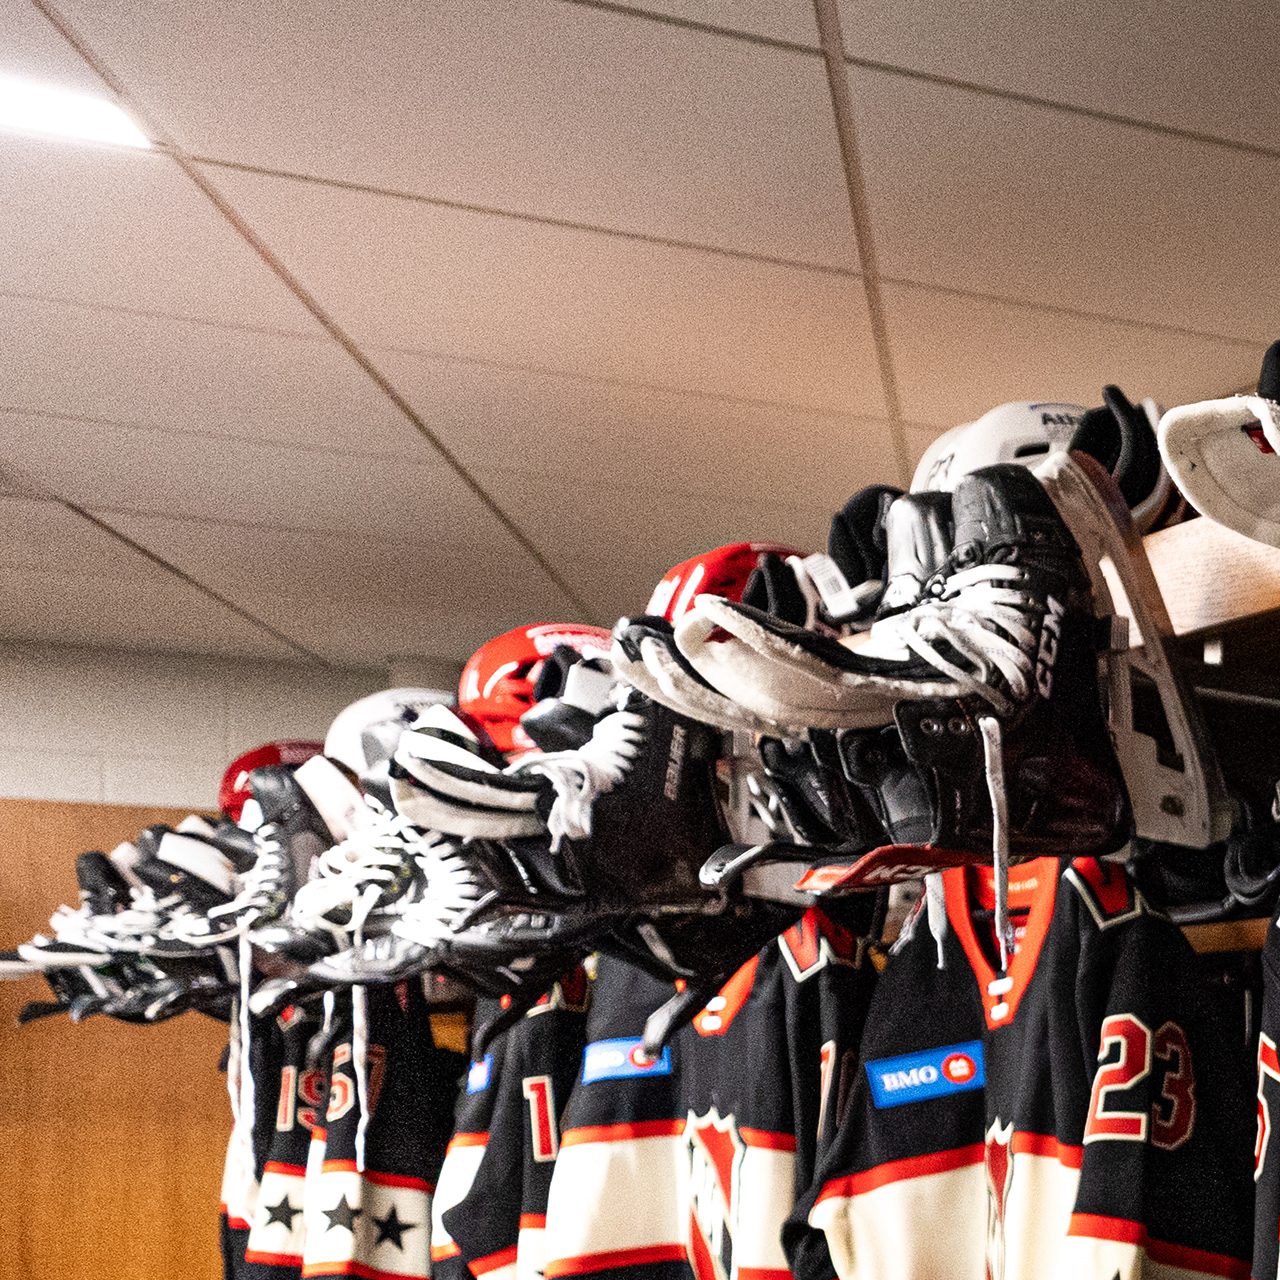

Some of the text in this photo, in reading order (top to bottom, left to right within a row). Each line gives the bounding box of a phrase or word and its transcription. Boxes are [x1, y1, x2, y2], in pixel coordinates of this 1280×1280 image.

[1036, 594, 1065, 699] CCM
[522, 1075, 558, 1163] 1
[881, 1063, 939, 1092] BMO
[1082, 1013, 1197, 1152] 23
